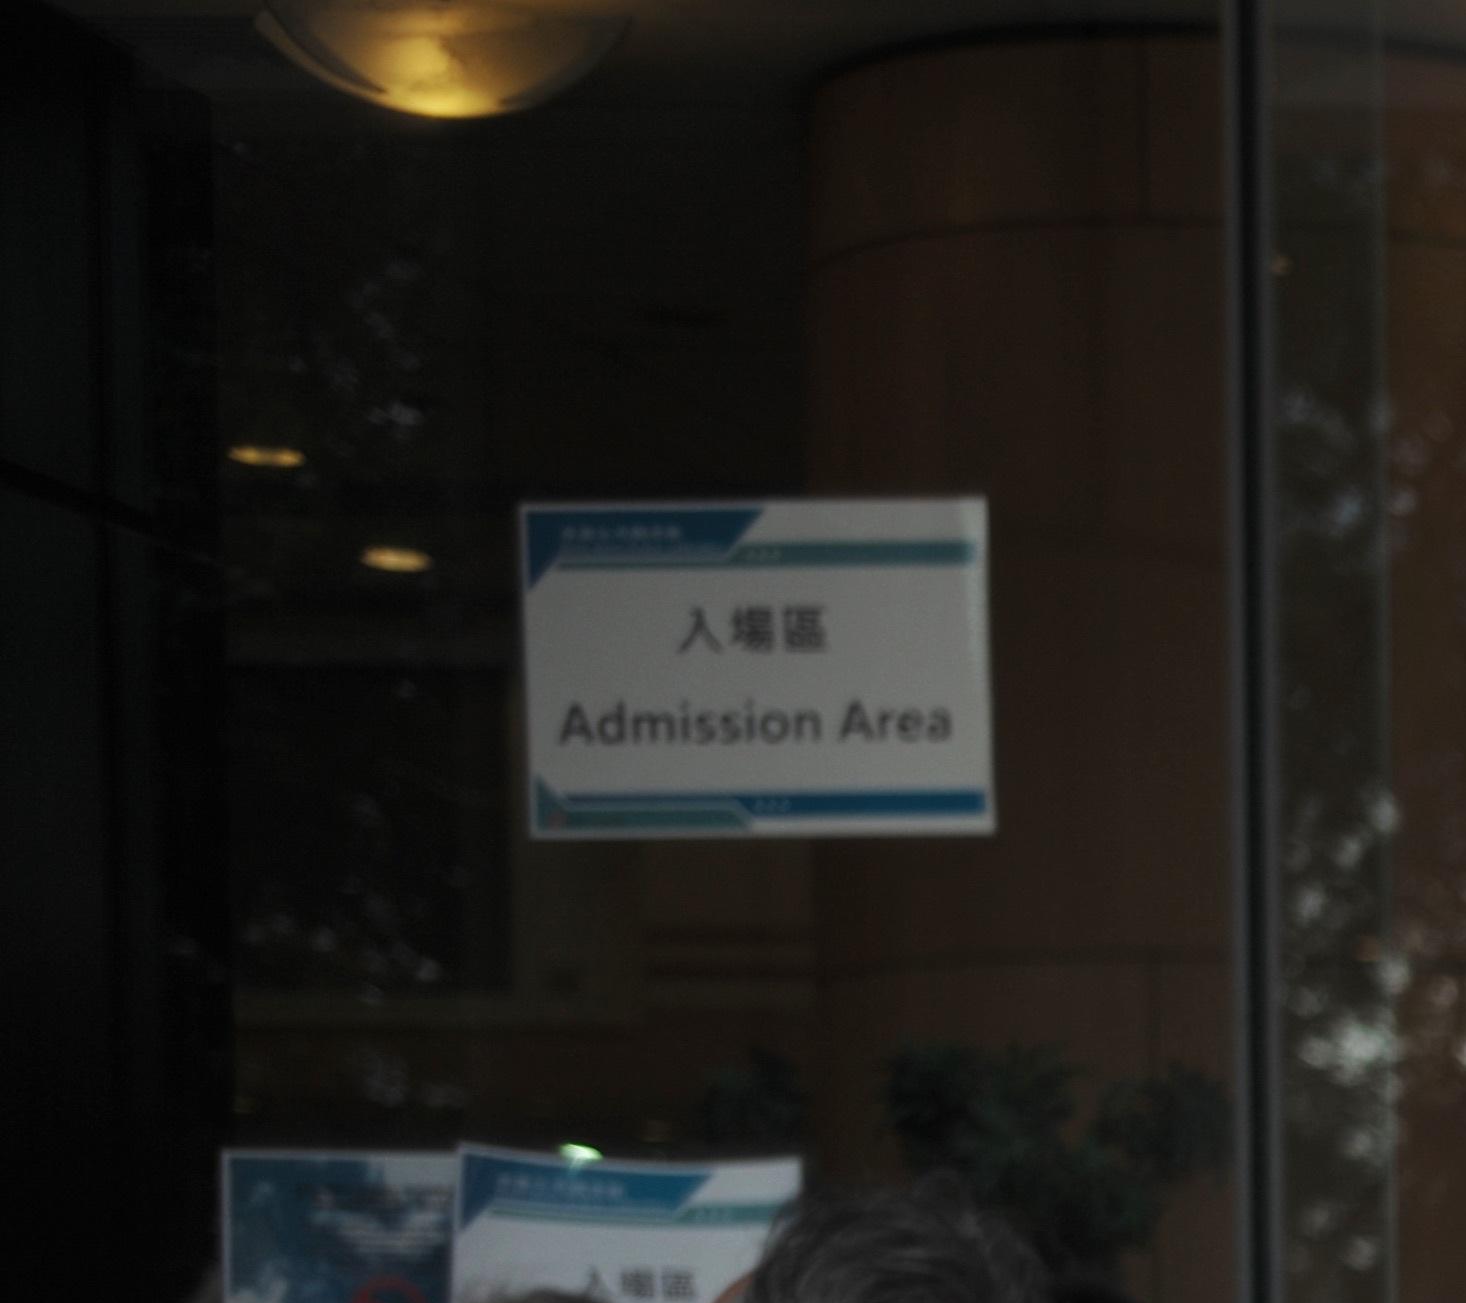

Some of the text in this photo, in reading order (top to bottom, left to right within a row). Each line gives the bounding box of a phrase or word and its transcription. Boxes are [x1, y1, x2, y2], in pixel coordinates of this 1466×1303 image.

[677, 605, 827, 655] 入場區
[557, 700, 954, 747] Admission Area
